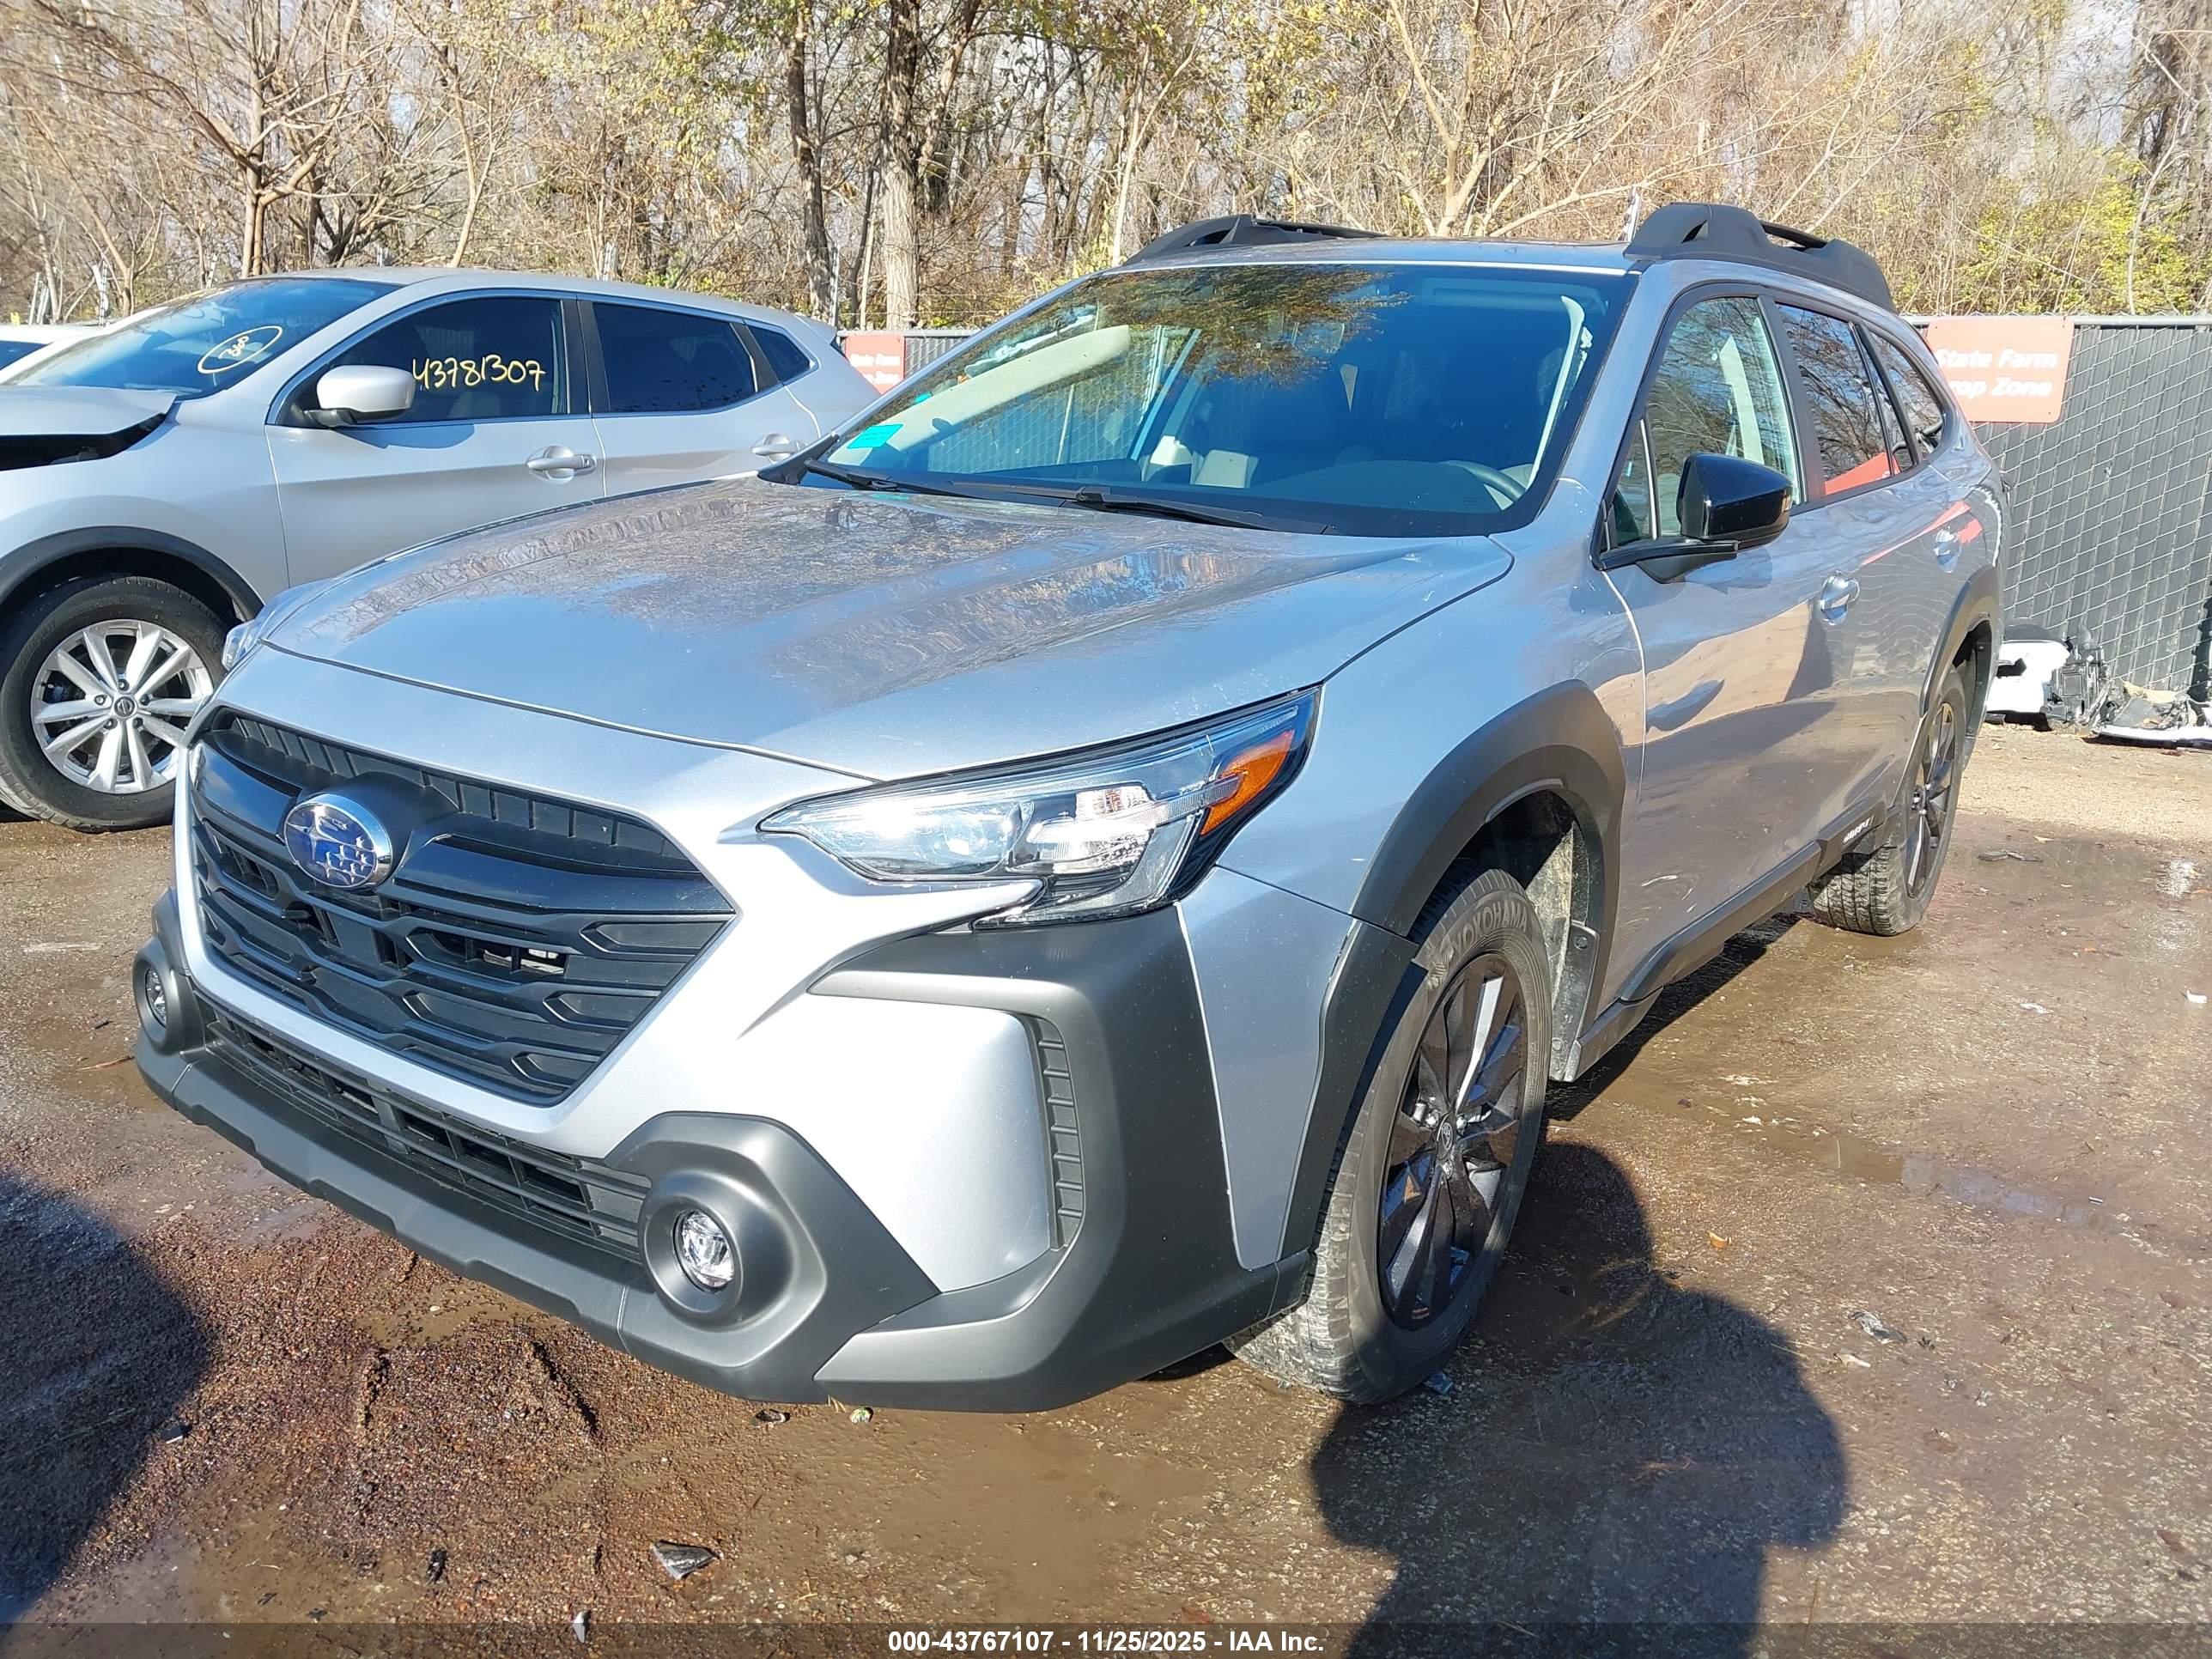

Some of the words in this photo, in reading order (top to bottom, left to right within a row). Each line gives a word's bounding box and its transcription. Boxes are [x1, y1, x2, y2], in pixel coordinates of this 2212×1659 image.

[1934, 349, 1992, 368] State
[1997, 348, 2058, 368] Farm
[412, 354, 546, 392] 43781307
[1990, 376, 2053, 397] Zone
